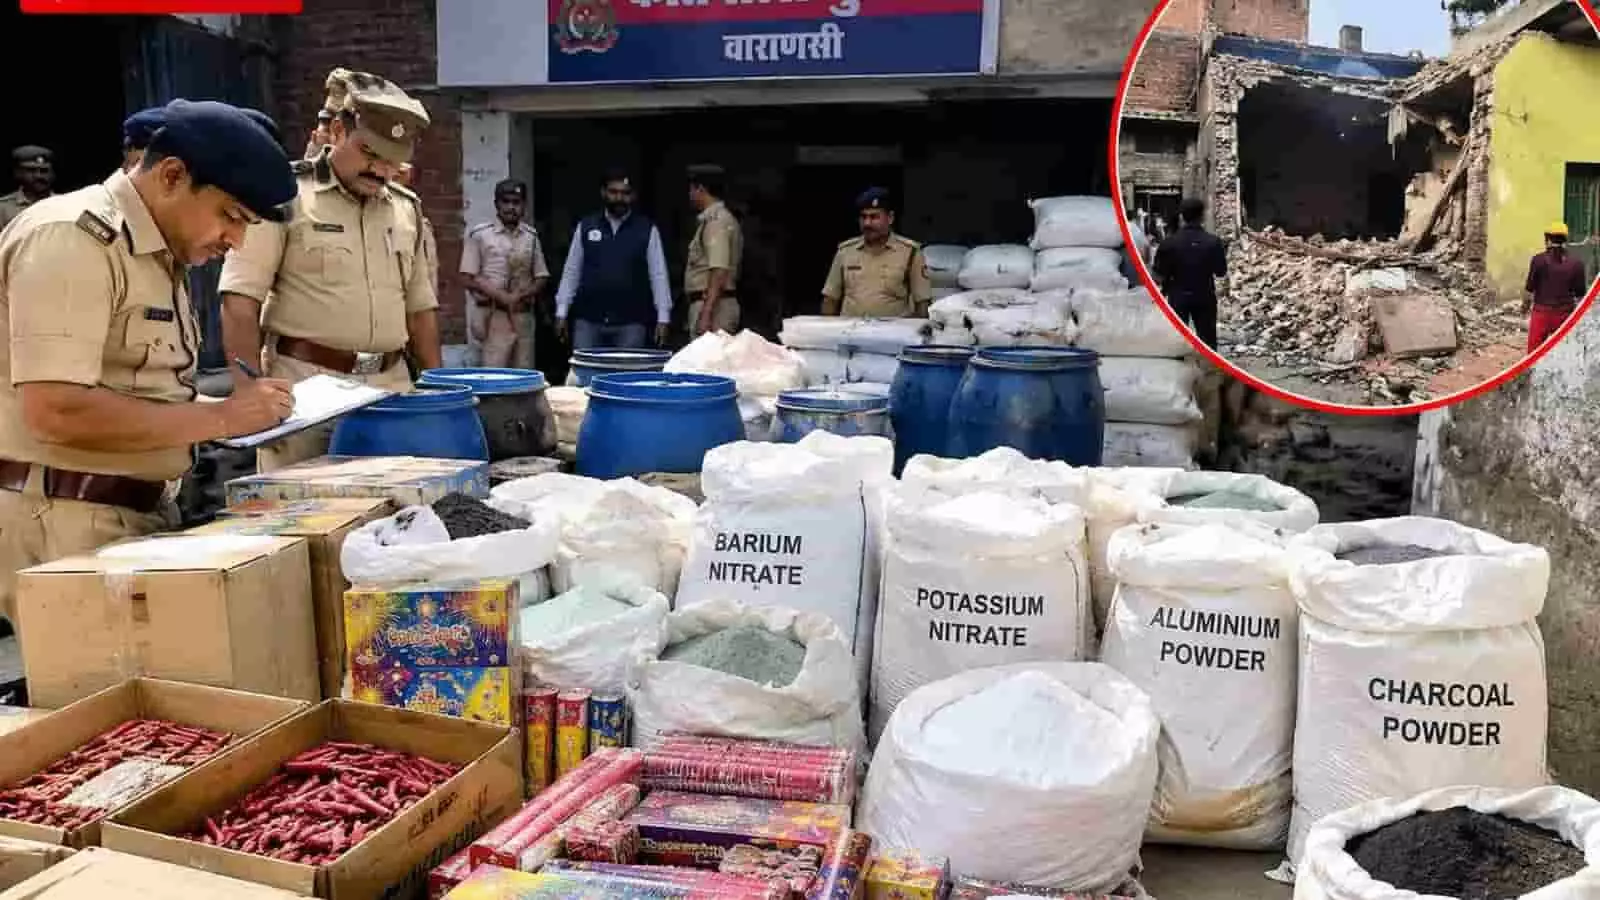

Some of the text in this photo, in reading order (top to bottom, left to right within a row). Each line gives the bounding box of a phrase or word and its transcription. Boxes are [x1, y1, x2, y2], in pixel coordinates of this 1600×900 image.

[722, 22, 845, 61] वाराणसी
[715, 533, 802, 556] BARIUM
[709, 561, 803, 585] NITRATE
[917, 587, 1044, 617] POTASSIUM
[929, 620, 1027, 647] NITRATE
[1149, 606, 1281, 640] ALUMINIUM
[1160, 641, 1265, 672] POWDER
[1368, 677, 1515, 708] CHARCOAL
[1383, 716, 1501, 747] POWDER
